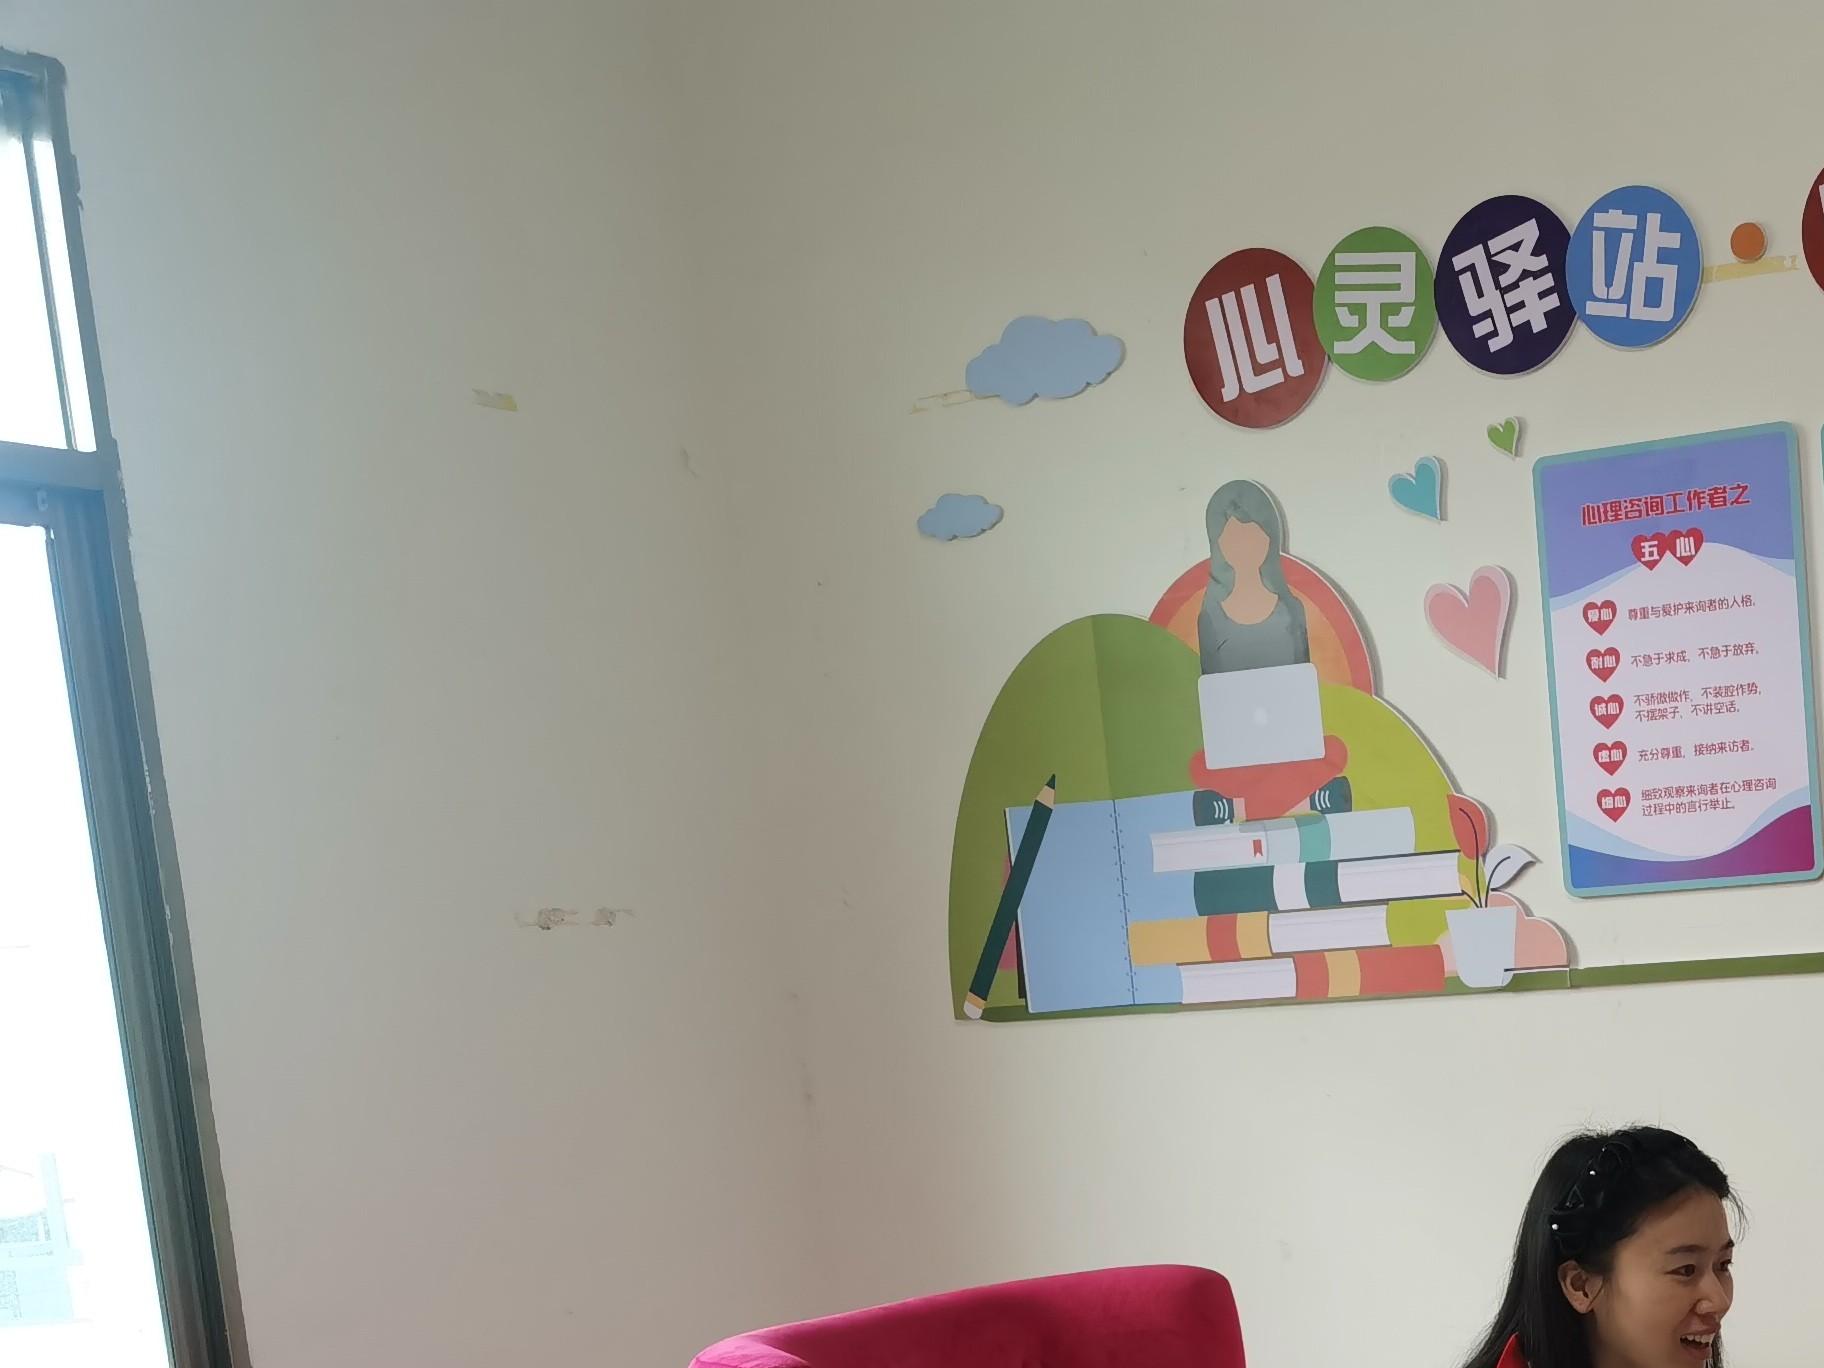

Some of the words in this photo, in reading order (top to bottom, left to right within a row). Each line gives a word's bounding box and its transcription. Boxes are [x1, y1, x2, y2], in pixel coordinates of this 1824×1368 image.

[1206, 210, 1681, 403] 心灵驿站
[1580, 480, 1750, 527] 心理咨询工作者之
[1640, 535, 1694, 562] 五心
[1590, 654, 1615, 669] 耐心
[1594, 701, 1619, 716] 诚心
[1601, 795, 1626, 809] 细心
